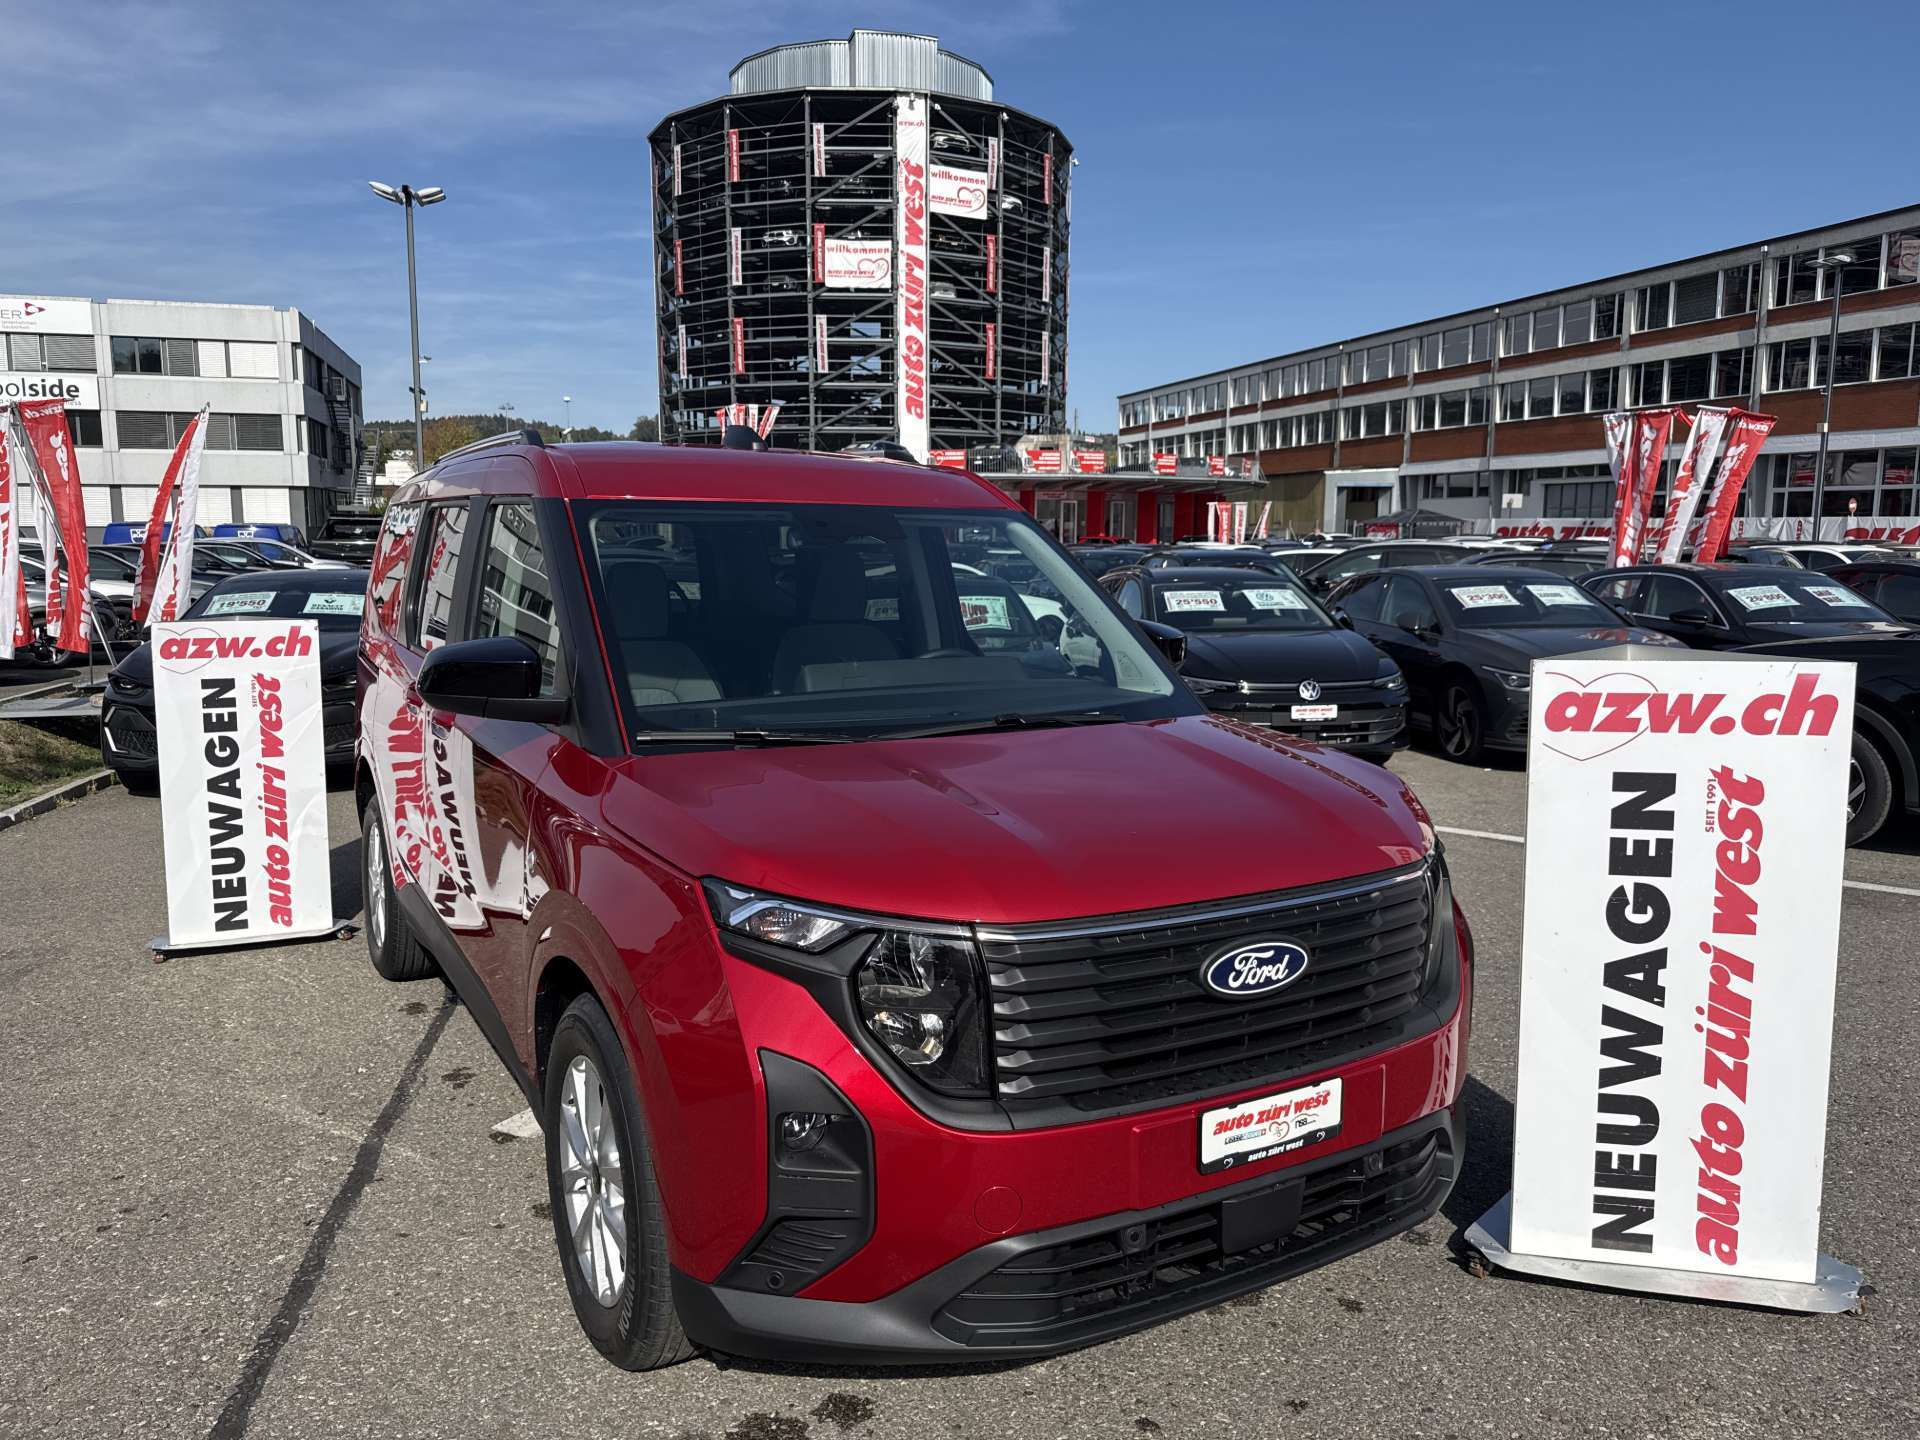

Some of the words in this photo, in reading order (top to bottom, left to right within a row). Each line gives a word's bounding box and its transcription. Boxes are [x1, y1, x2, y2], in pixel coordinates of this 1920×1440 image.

[901, 158, 924, 246] west
[930, 169, 986, 186] willkommen
[826, 244, 890, 254] willkommen
[900, 250, 925, 334] züri
[0, 377, 80, 398] olside
[901, 335, 925, 420] auto
[159, 626, 312, 660] azw.ch
[251, 672, 284, 758] west
[1544, 673, 1839, 736] azw.ch
[200, 677, 249, 932] NEUWAGEN
[256, 762, 289, 843] züri
[1705, 809, 1715, 833] SEIT
[1706, 778, 1717, 807] 1991
[262, 844, 293, 928] auto
[1708, 764, 1765, 936] west
[1228, 949, 1290, 988] Ford
[1591, 771, 1677, 1254] NEUWAGEN
[1694, 940, 1755, 1105] züri
[1213, 1112, 1254, 1136] auto
[1255, 1099, 1292, 1125] züri
[1293, 1089, 1331, 1115] west
[1248, 1149, 1266, 1162] auto
[1268, 1144, 1286, 1156] züri
[1286, 1139, 1304, 1151] west
[1688, 1102, 1745, 1266] auto
